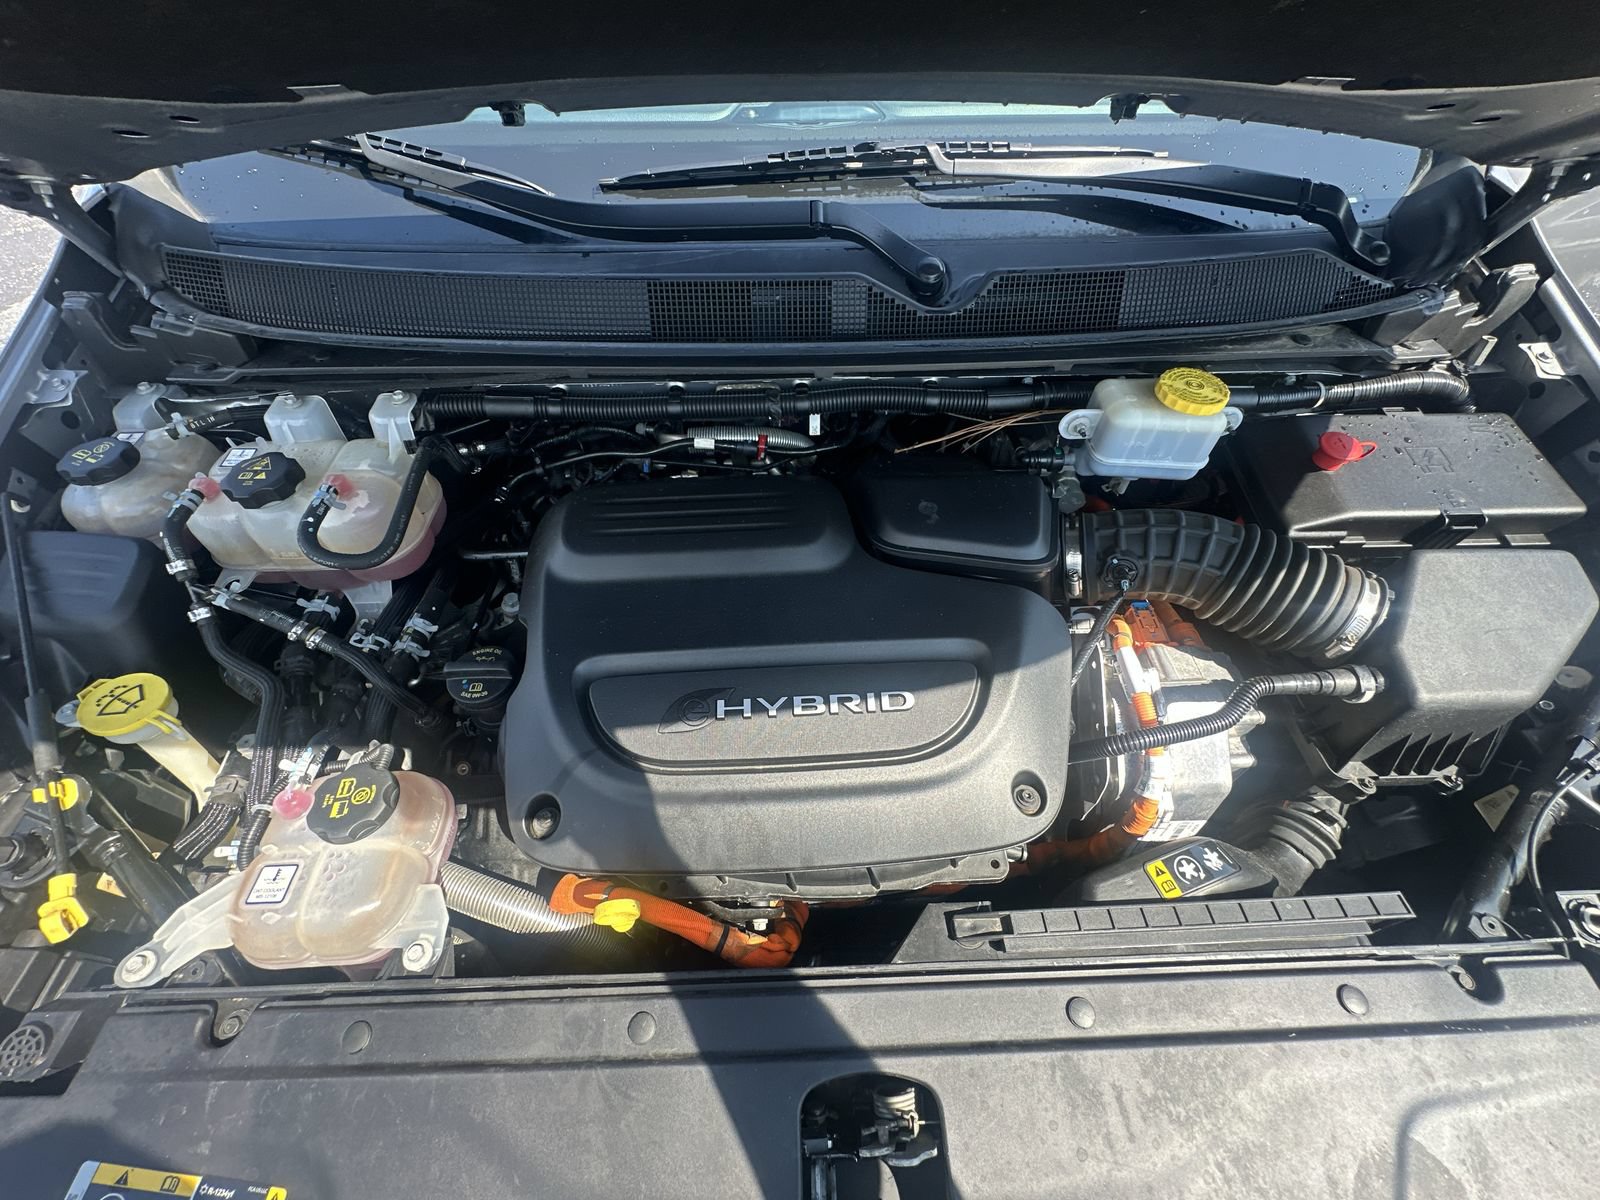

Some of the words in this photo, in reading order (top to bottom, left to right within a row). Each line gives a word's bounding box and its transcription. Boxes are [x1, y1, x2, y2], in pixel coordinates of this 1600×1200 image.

[472, 648, 494, 656] ENGINE
[460, 691, 471, 699] SAE
[207, 1186, 236, 1199] R-1234yf
